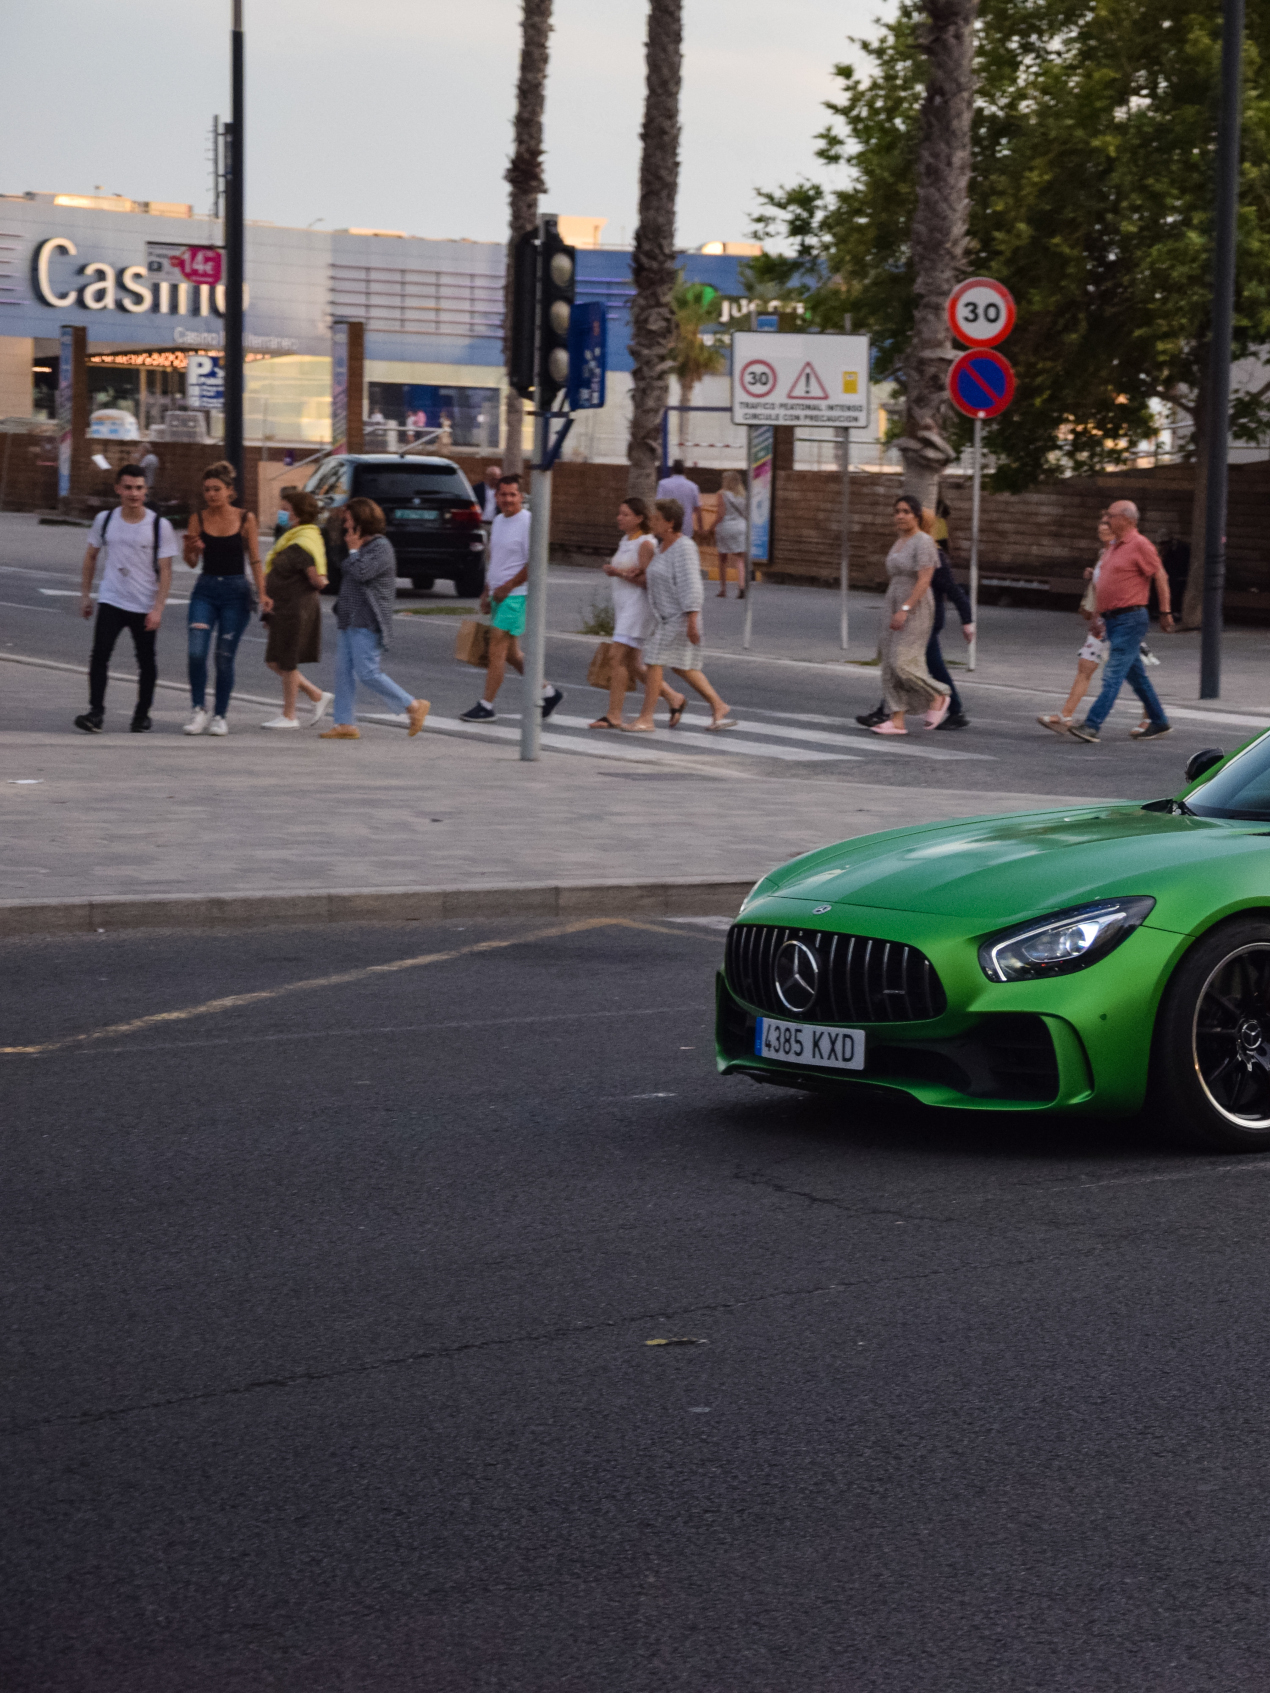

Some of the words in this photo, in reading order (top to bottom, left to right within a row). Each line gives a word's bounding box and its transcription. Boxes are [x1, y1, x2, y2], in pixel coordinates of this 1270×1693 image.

[963, 302, 1001, 324] 30
[187, 356, 213, 384] P
[747, 371, 769, 386] 30
[742, 412, 780, 422] CIRCULE
[782, 413, 801, 422] CON
[764, 1024, 804, 1057] 4385
[811, 1030, 855, 1063] KXD
